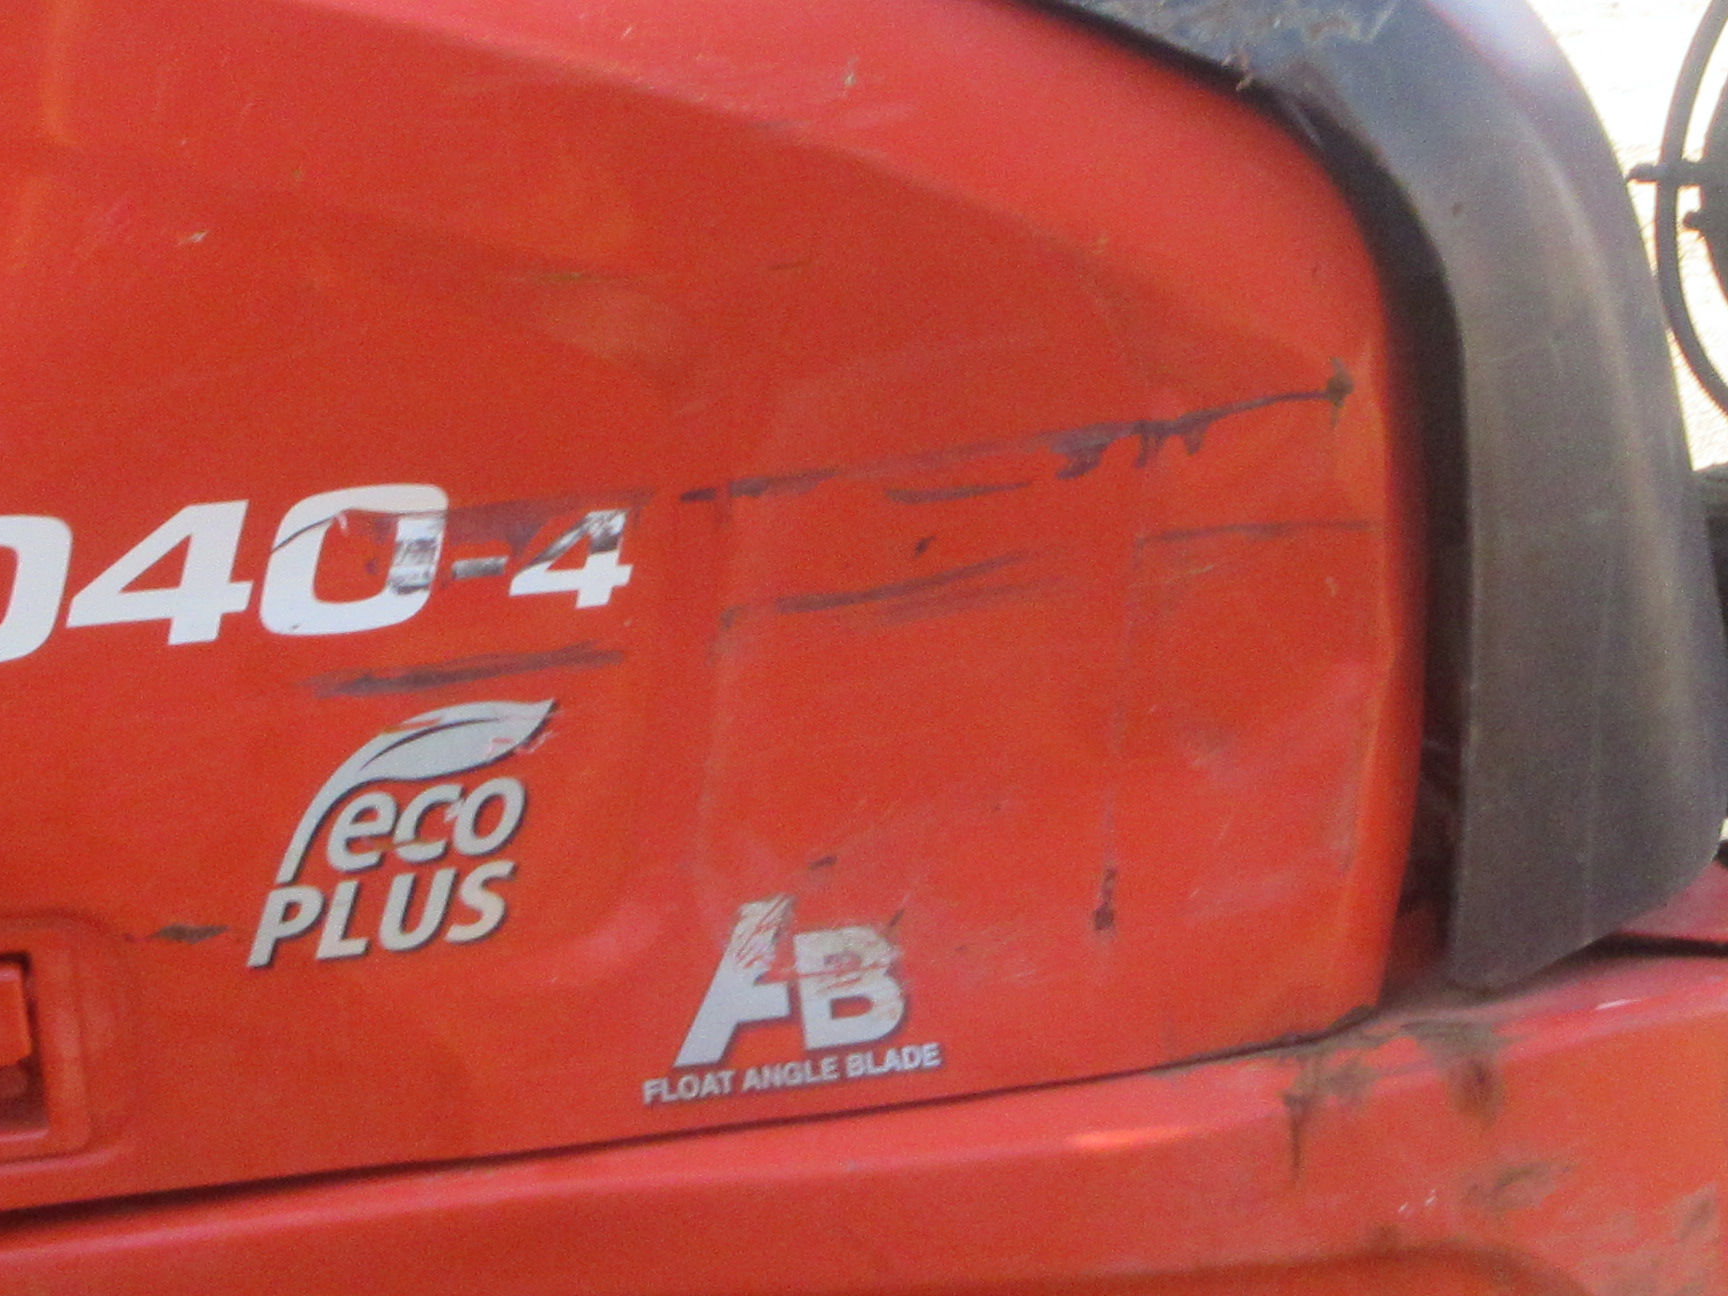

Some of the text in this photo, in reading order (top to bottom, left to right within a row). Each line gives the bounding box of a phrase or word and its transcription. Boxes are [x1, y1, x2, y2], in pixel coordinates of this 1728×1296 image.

[326, 776, 525, 874] eco
[246, 860, 517, 969] PLUS
[643, 1043, 941, 1105] FLOAT ANGLE BLADE
